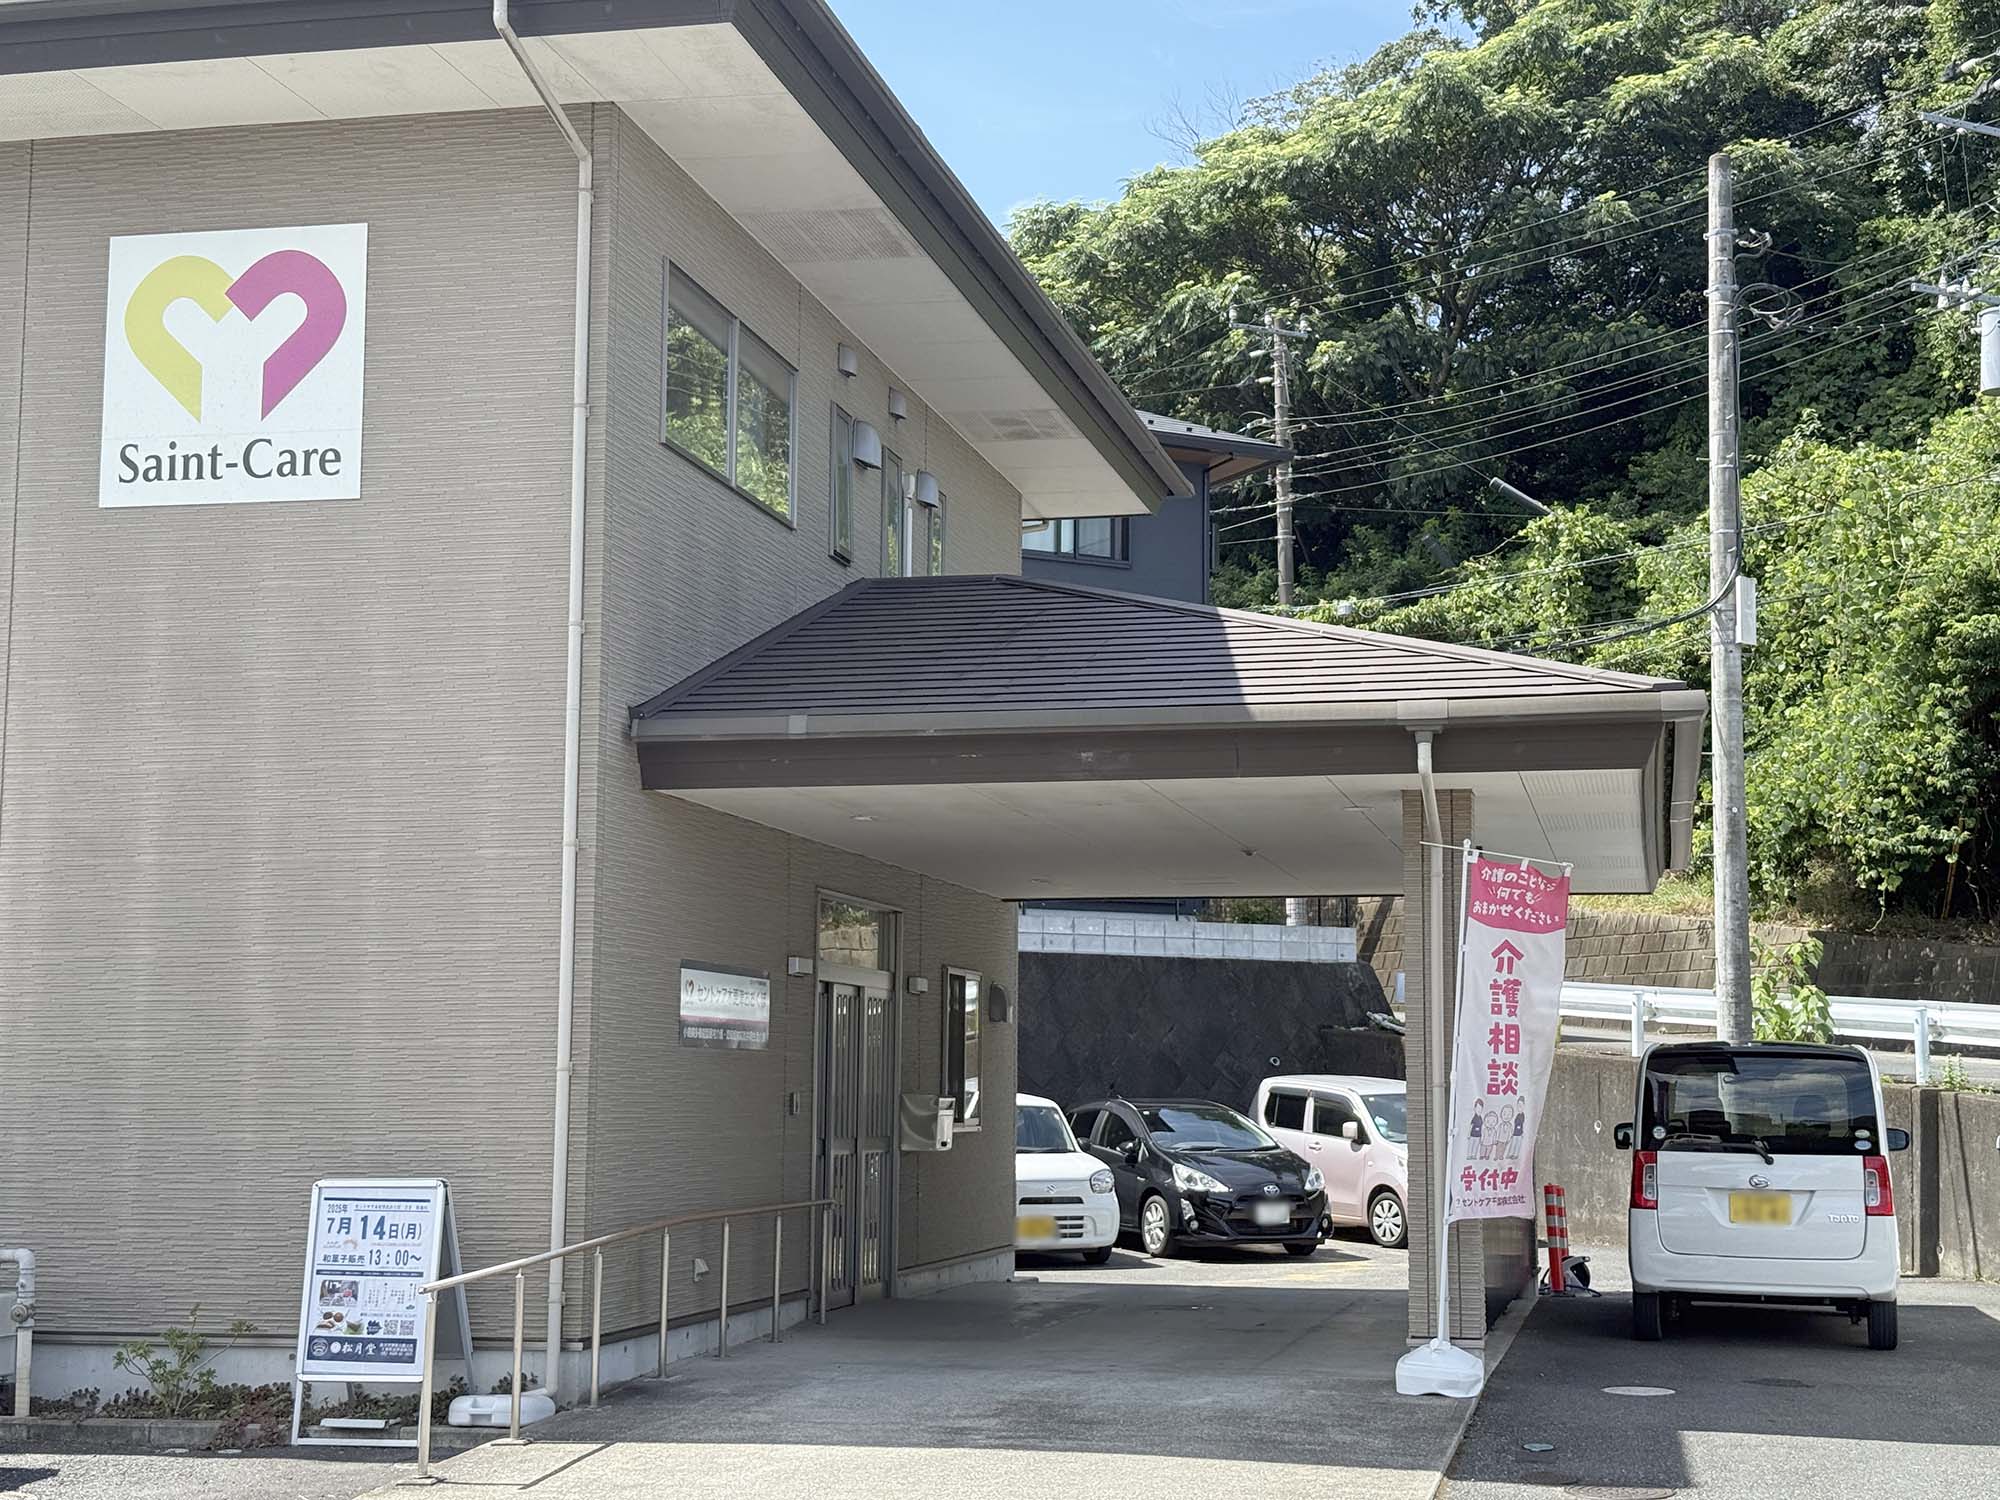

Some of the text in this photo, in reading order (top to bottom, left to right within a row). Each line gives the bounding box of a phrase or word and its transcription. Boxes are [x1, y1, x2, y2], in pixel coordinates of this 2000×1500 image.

[119, 438, 342, 483] Saint-Care
[1481, 866, 1556, 892] 介護のことなら
[1497, 886, 1535, 905] 何でも
[1472, 900, 1560, 925] おまかせください
[1487, 939, 1525, 1096] 介護相談
[1460, 1165, 1519, 1192] 受付中
